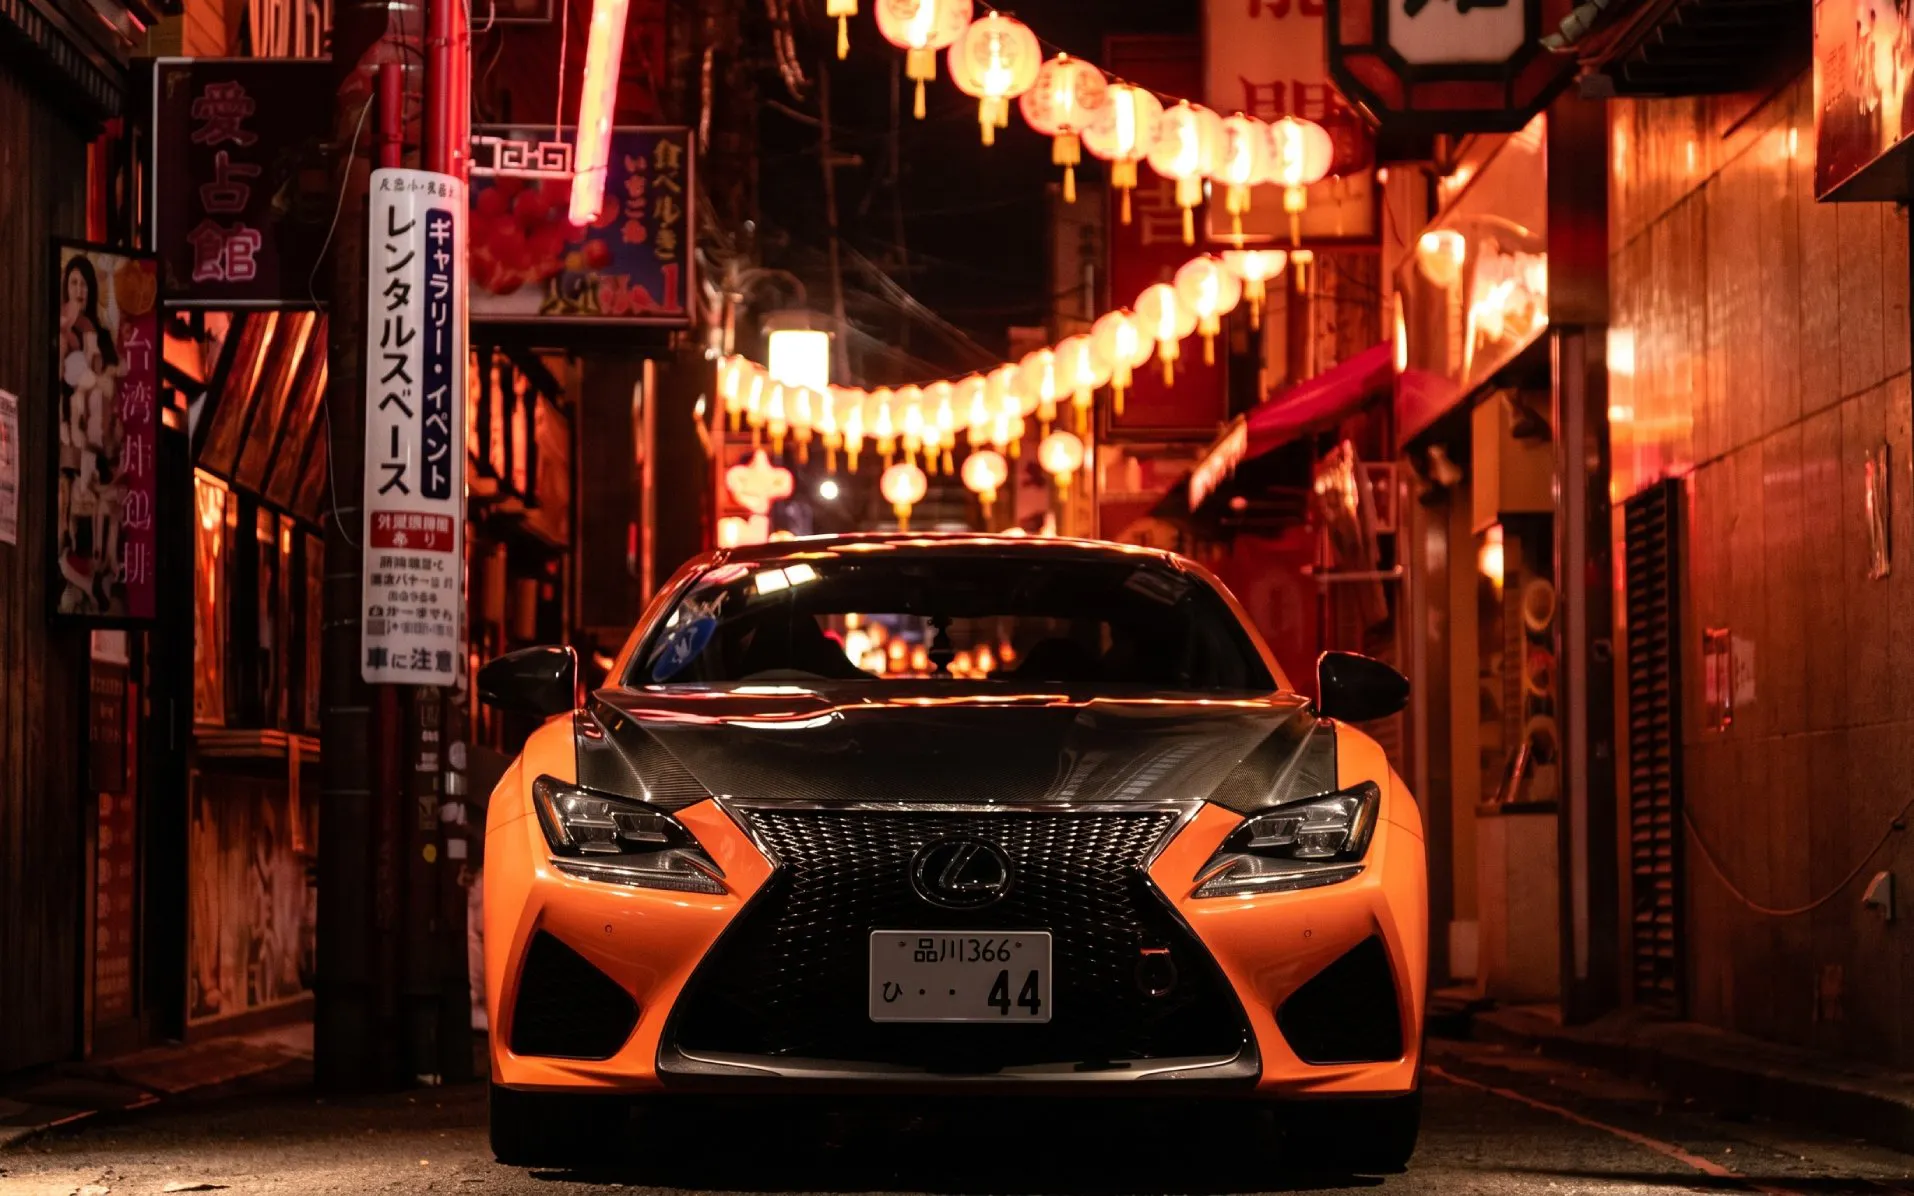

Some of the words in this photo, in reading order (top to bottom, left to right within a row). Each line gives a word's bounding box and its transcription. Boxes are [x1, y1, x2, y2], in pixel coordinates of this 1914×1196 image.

[187, 81, 262, 281] 愛占館
[882, 981, 903, 1003] ひ
